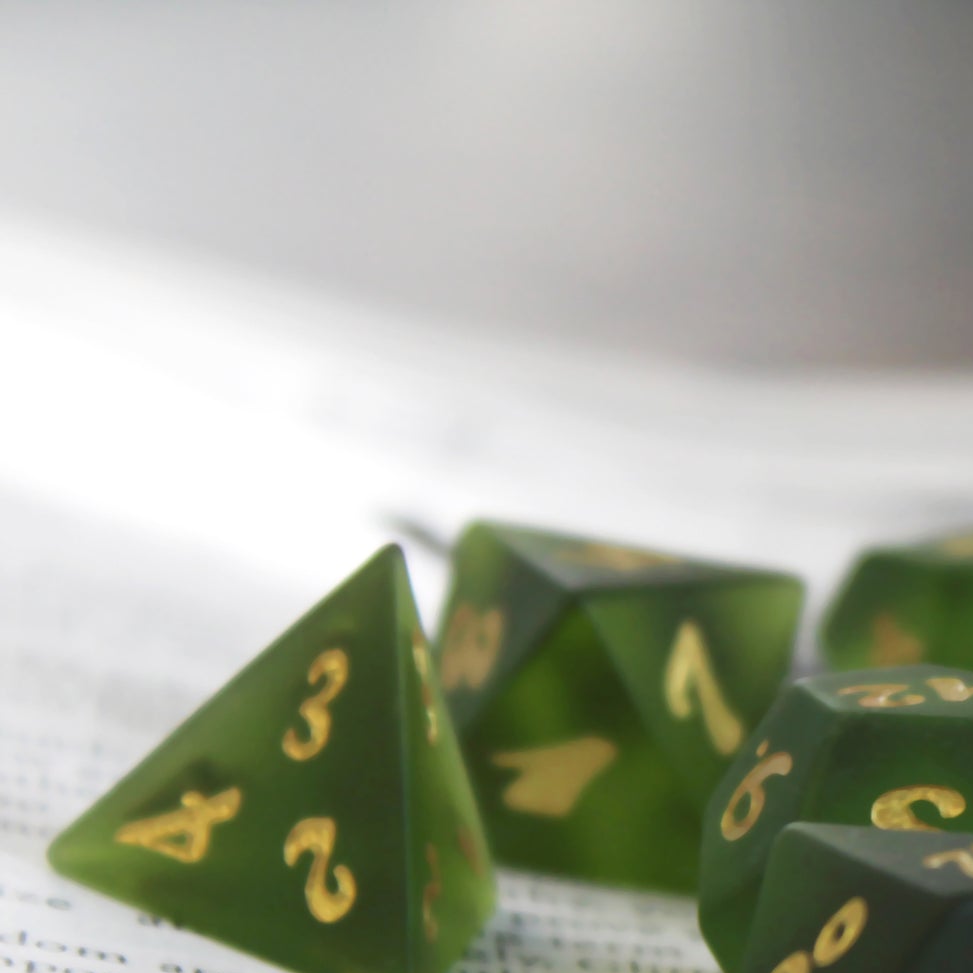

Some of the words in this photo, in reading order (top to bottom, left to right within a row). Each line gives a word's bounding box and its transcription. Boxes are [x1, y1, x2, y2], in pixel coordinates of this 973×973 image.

[282, 648, 349, 760] 3
[115, 786, 242, 864] 4
[284, 816, 357, 924] 2
